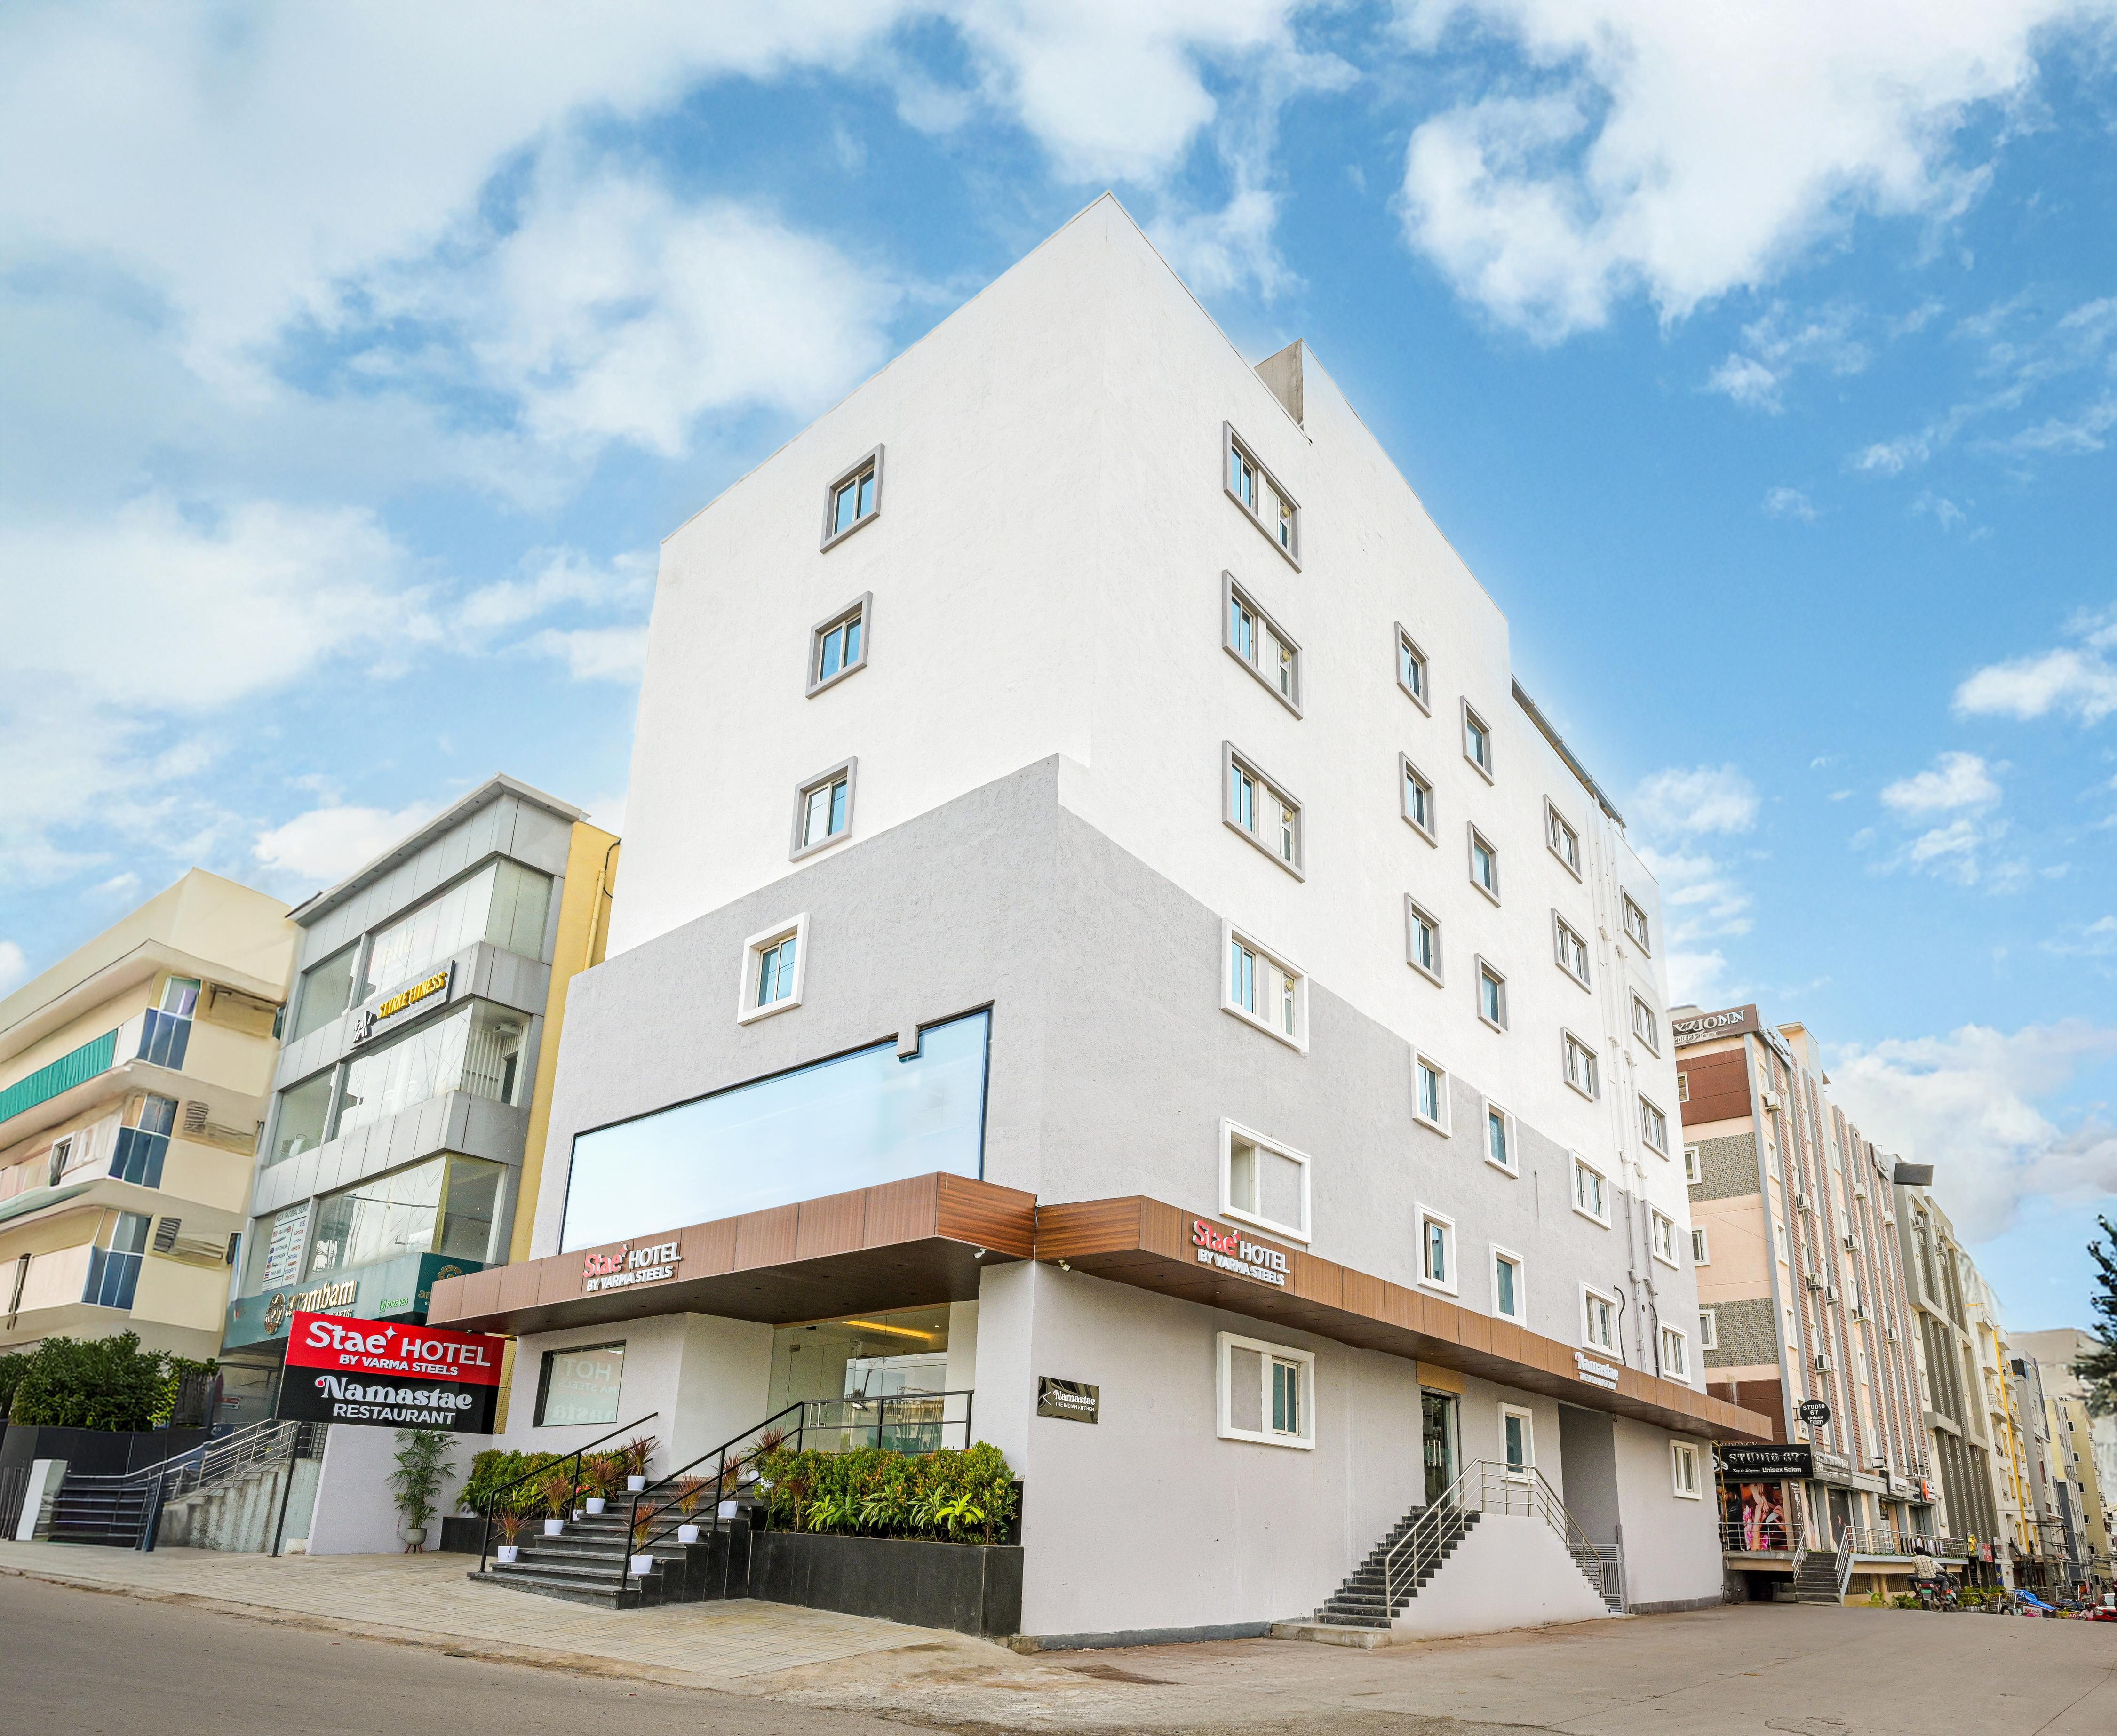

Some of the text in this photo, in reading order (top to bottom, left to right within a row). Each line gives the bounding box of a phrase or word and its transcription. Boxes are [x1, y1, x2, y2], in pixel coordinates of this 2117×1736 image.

[377, 989, 410, 1019] STYRKE
[408, 972, 448, 1004] FITNESS
[583, 1242, 682, 1278] Stae HOTEL
[1192, 1220, 1290, 1274] Stae HOTEL
[587, 1265, 674, 1292] BY VARMA STEELS
[1197, 1249, 1285, 1287] BY VARMA STEELS
[386, 1298, 408, 1309] PURE VEG
[306, 1321, 491, 1367] Stae HOTEL
[340, 1354, 458, 1376] BY VARMA STEELS
[315, 1375, 473, 1410] Namastae
[1053, 1390, 1096, 1405] Namastae
[333, 1403, 455, 1425] RESTAURANT
[1729, 1452, 1779, 1464] STUDIO
